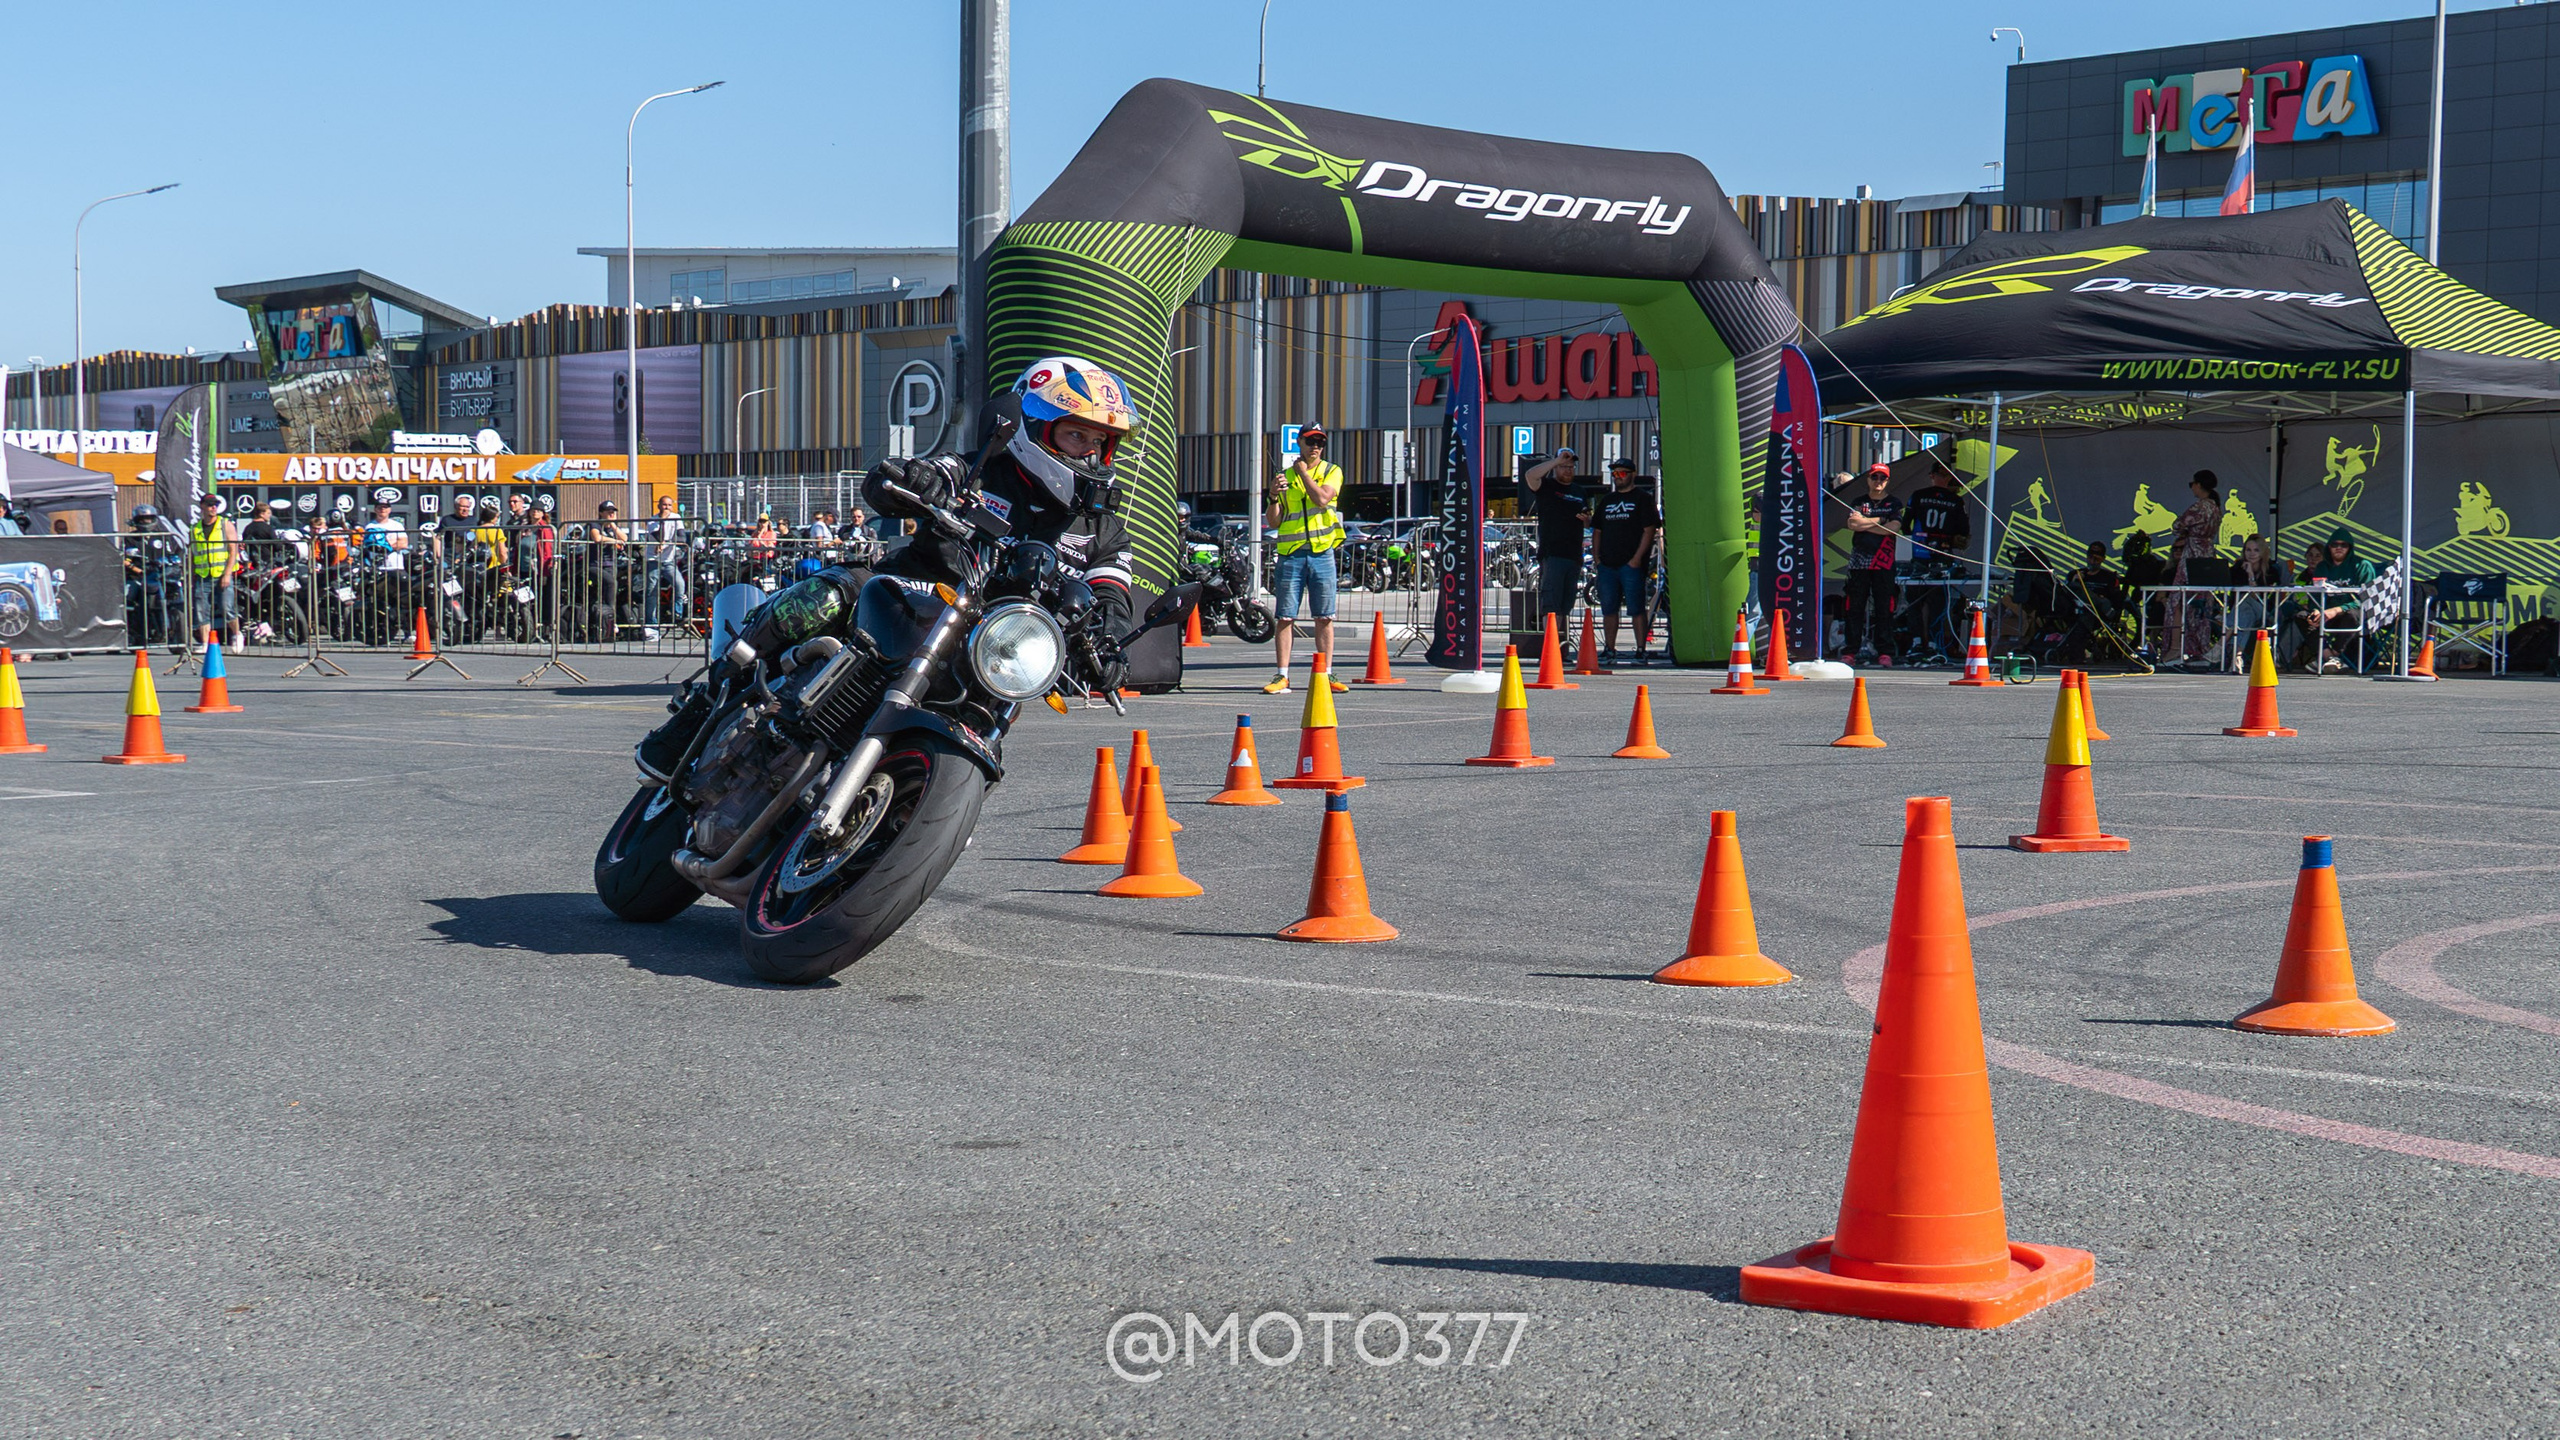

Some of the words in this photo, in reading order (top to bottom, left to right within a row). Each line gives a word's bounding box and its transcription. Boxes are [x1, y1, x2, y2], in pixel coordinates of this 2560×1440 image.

[449, 365, 493, 391] ВКУСНЫЙ
[2101, 358, 2400, 381] WWW.DRAGON-FLY.SU
[1518, 431, 1530, 450] P
[284, 456, 496, 482] АВТОЗАПЧАСТИ
[563, 458, 600, 469] АВТО
[1925, 508, 1947, 529] 01
[1055, 541, 1088, 563] HONDA
